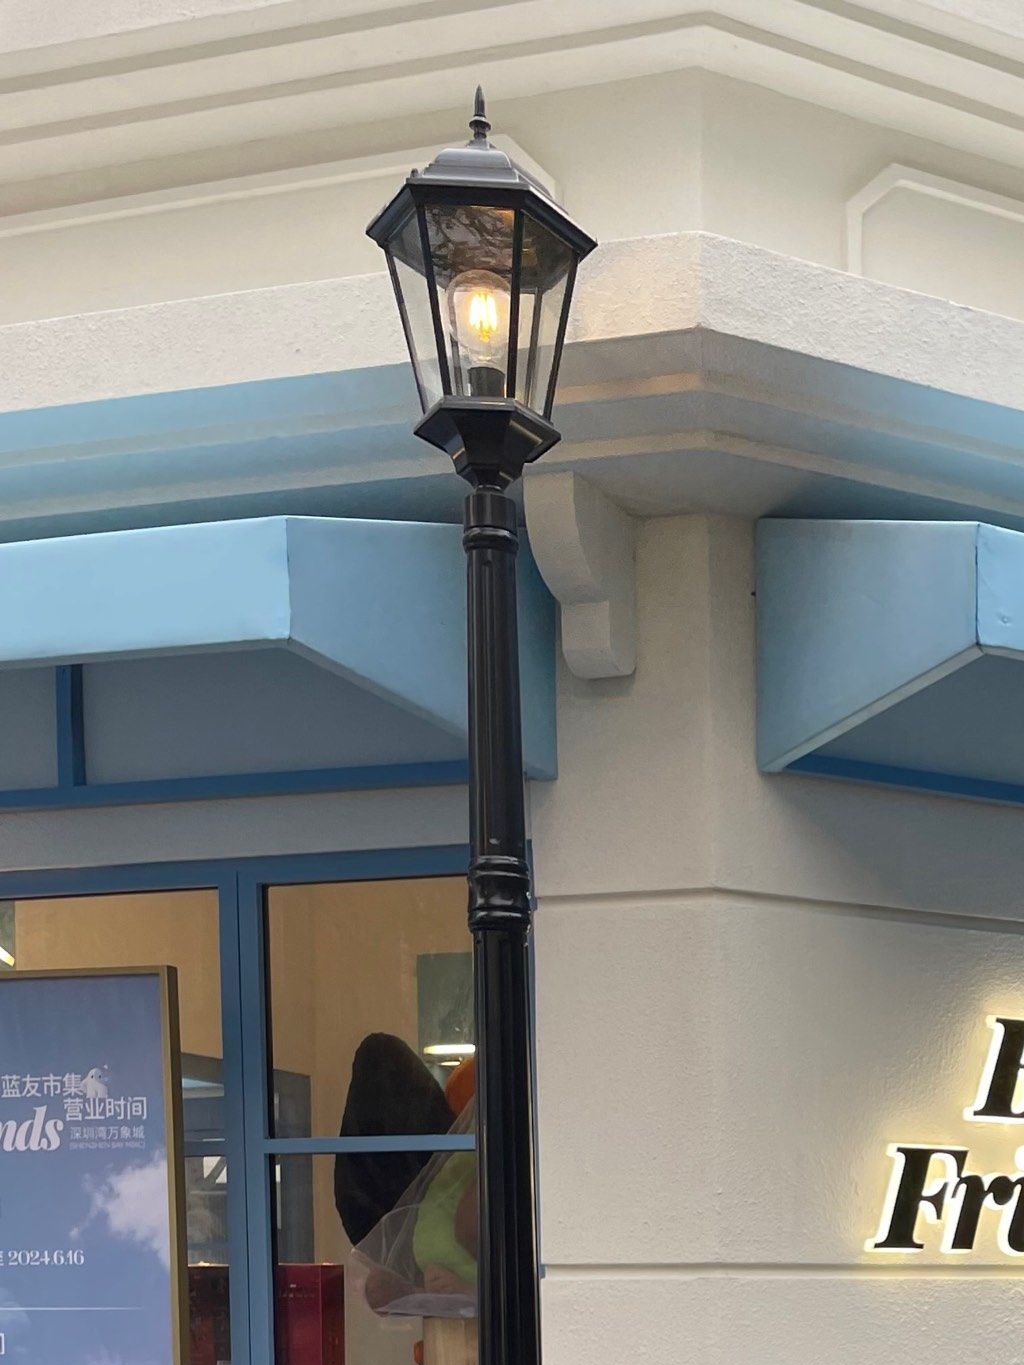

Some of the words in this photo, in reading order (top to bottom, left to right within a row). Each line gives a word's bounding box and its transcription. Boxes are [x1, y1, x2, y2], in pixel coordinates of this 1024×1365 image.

[1, 1072, 84, 1098] 蓝友市集
[63, 1096, 147, 1121] 营业时间
